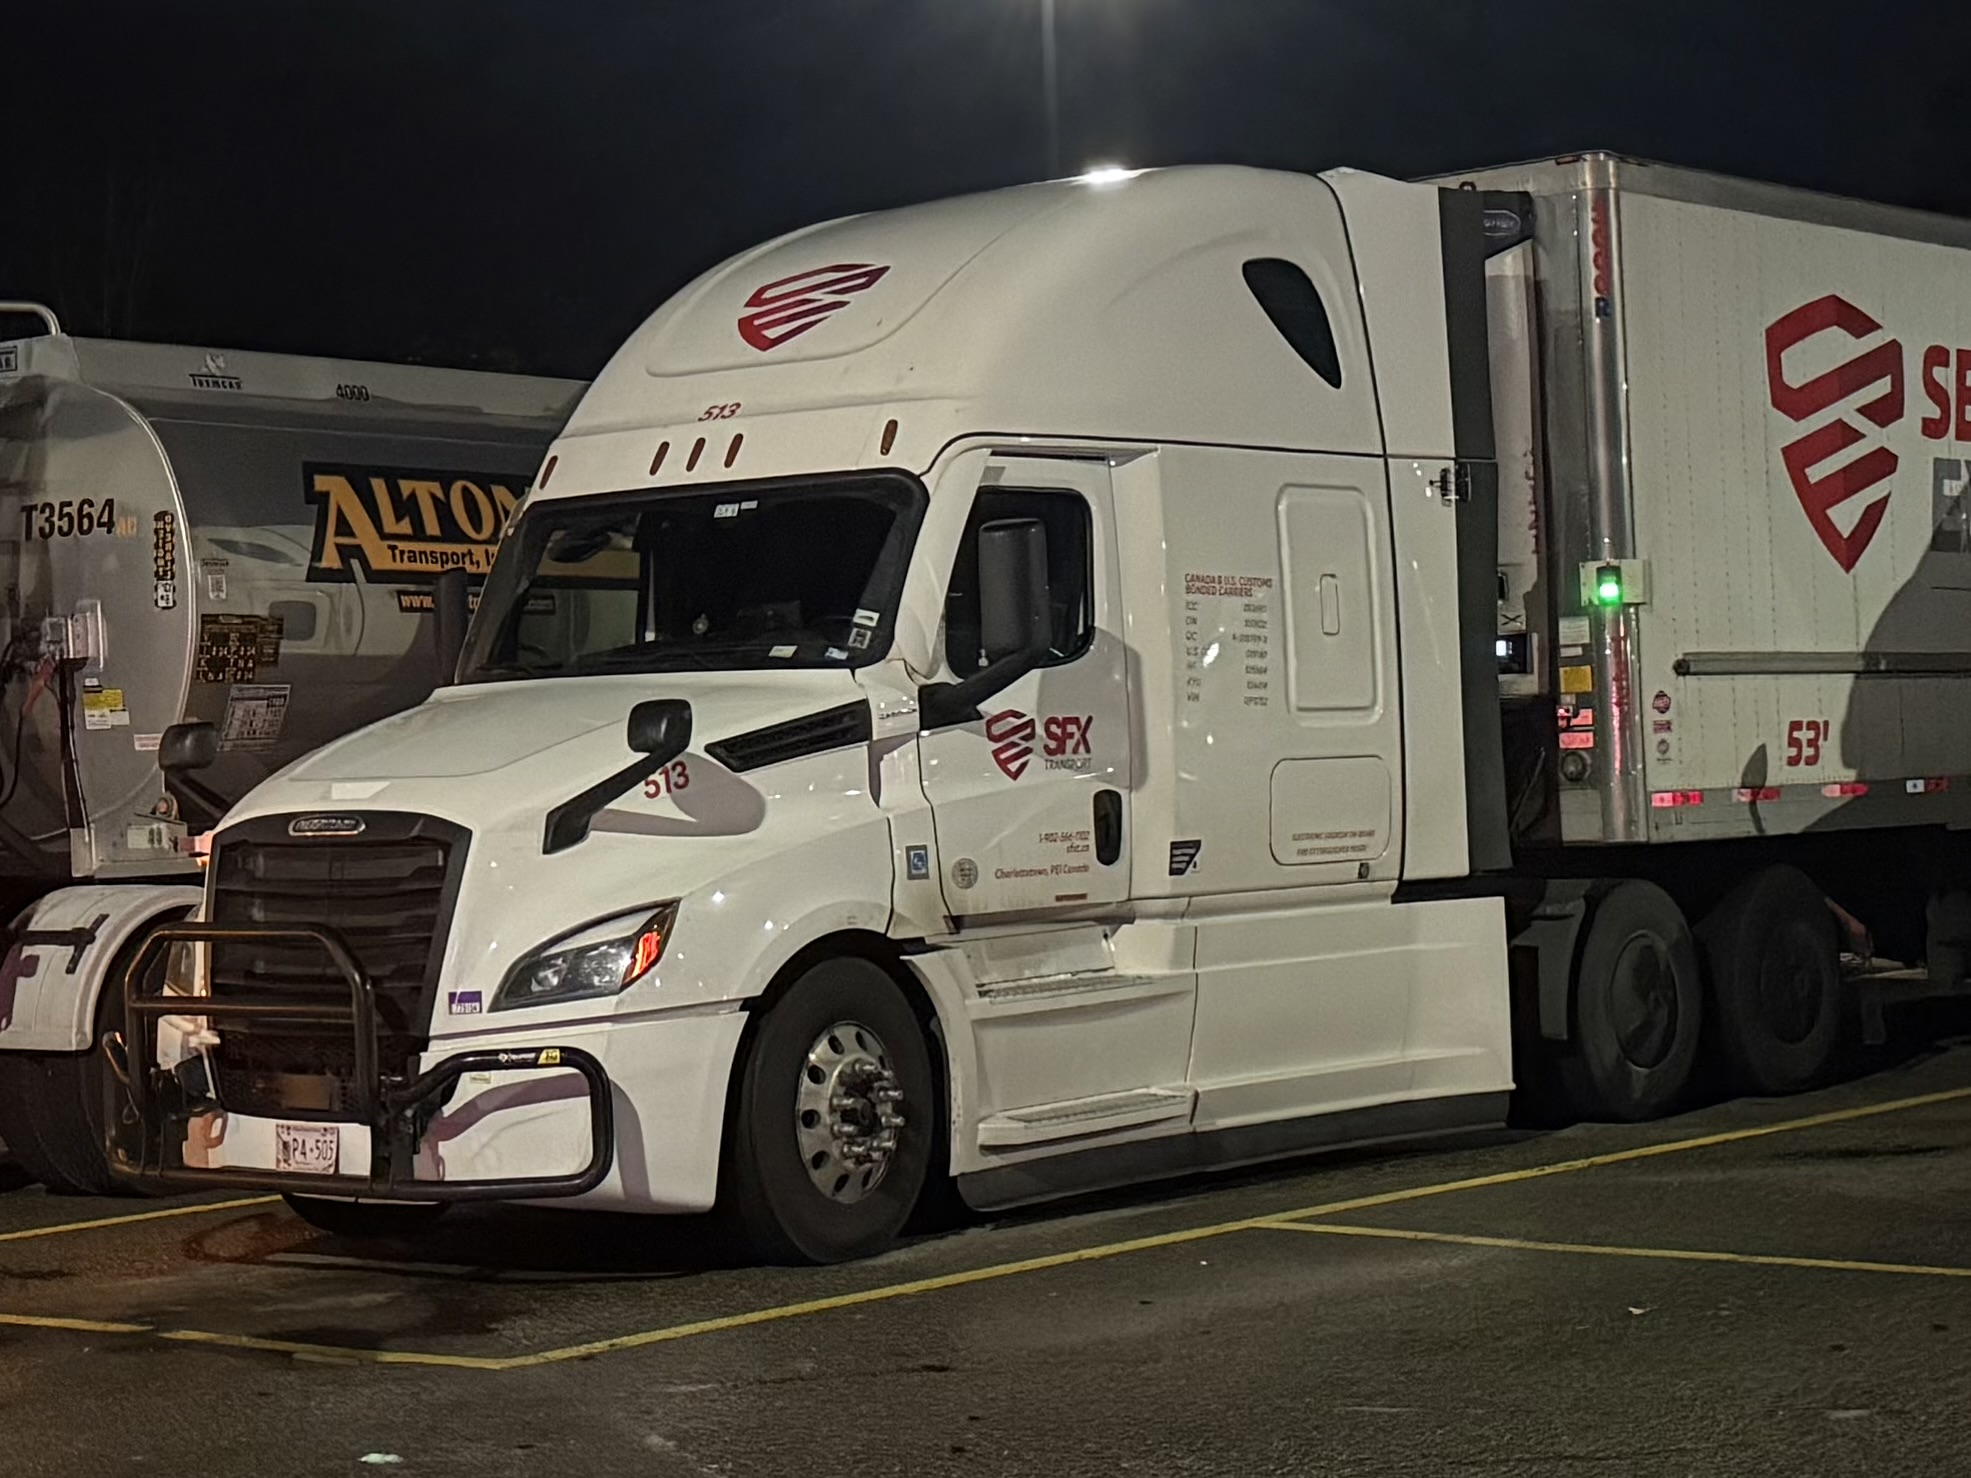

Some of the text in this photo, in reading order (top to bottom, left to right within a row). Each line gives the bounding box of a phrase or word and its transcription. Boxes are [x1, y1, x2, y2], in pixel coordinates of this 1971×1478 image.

[336, 384, 369, 401] 4000
[697, 402, 741, 421] 513
[20, 498, 115, 541] T3564
[387, 545, 480, 569] Transport,
[1043, 715, 1093, 756] SFX
[1787, 720, 1829, 767] 53'
[644, 760, 690, 799] 513
[1045, 758, 1092, 771] TRANSPORT
